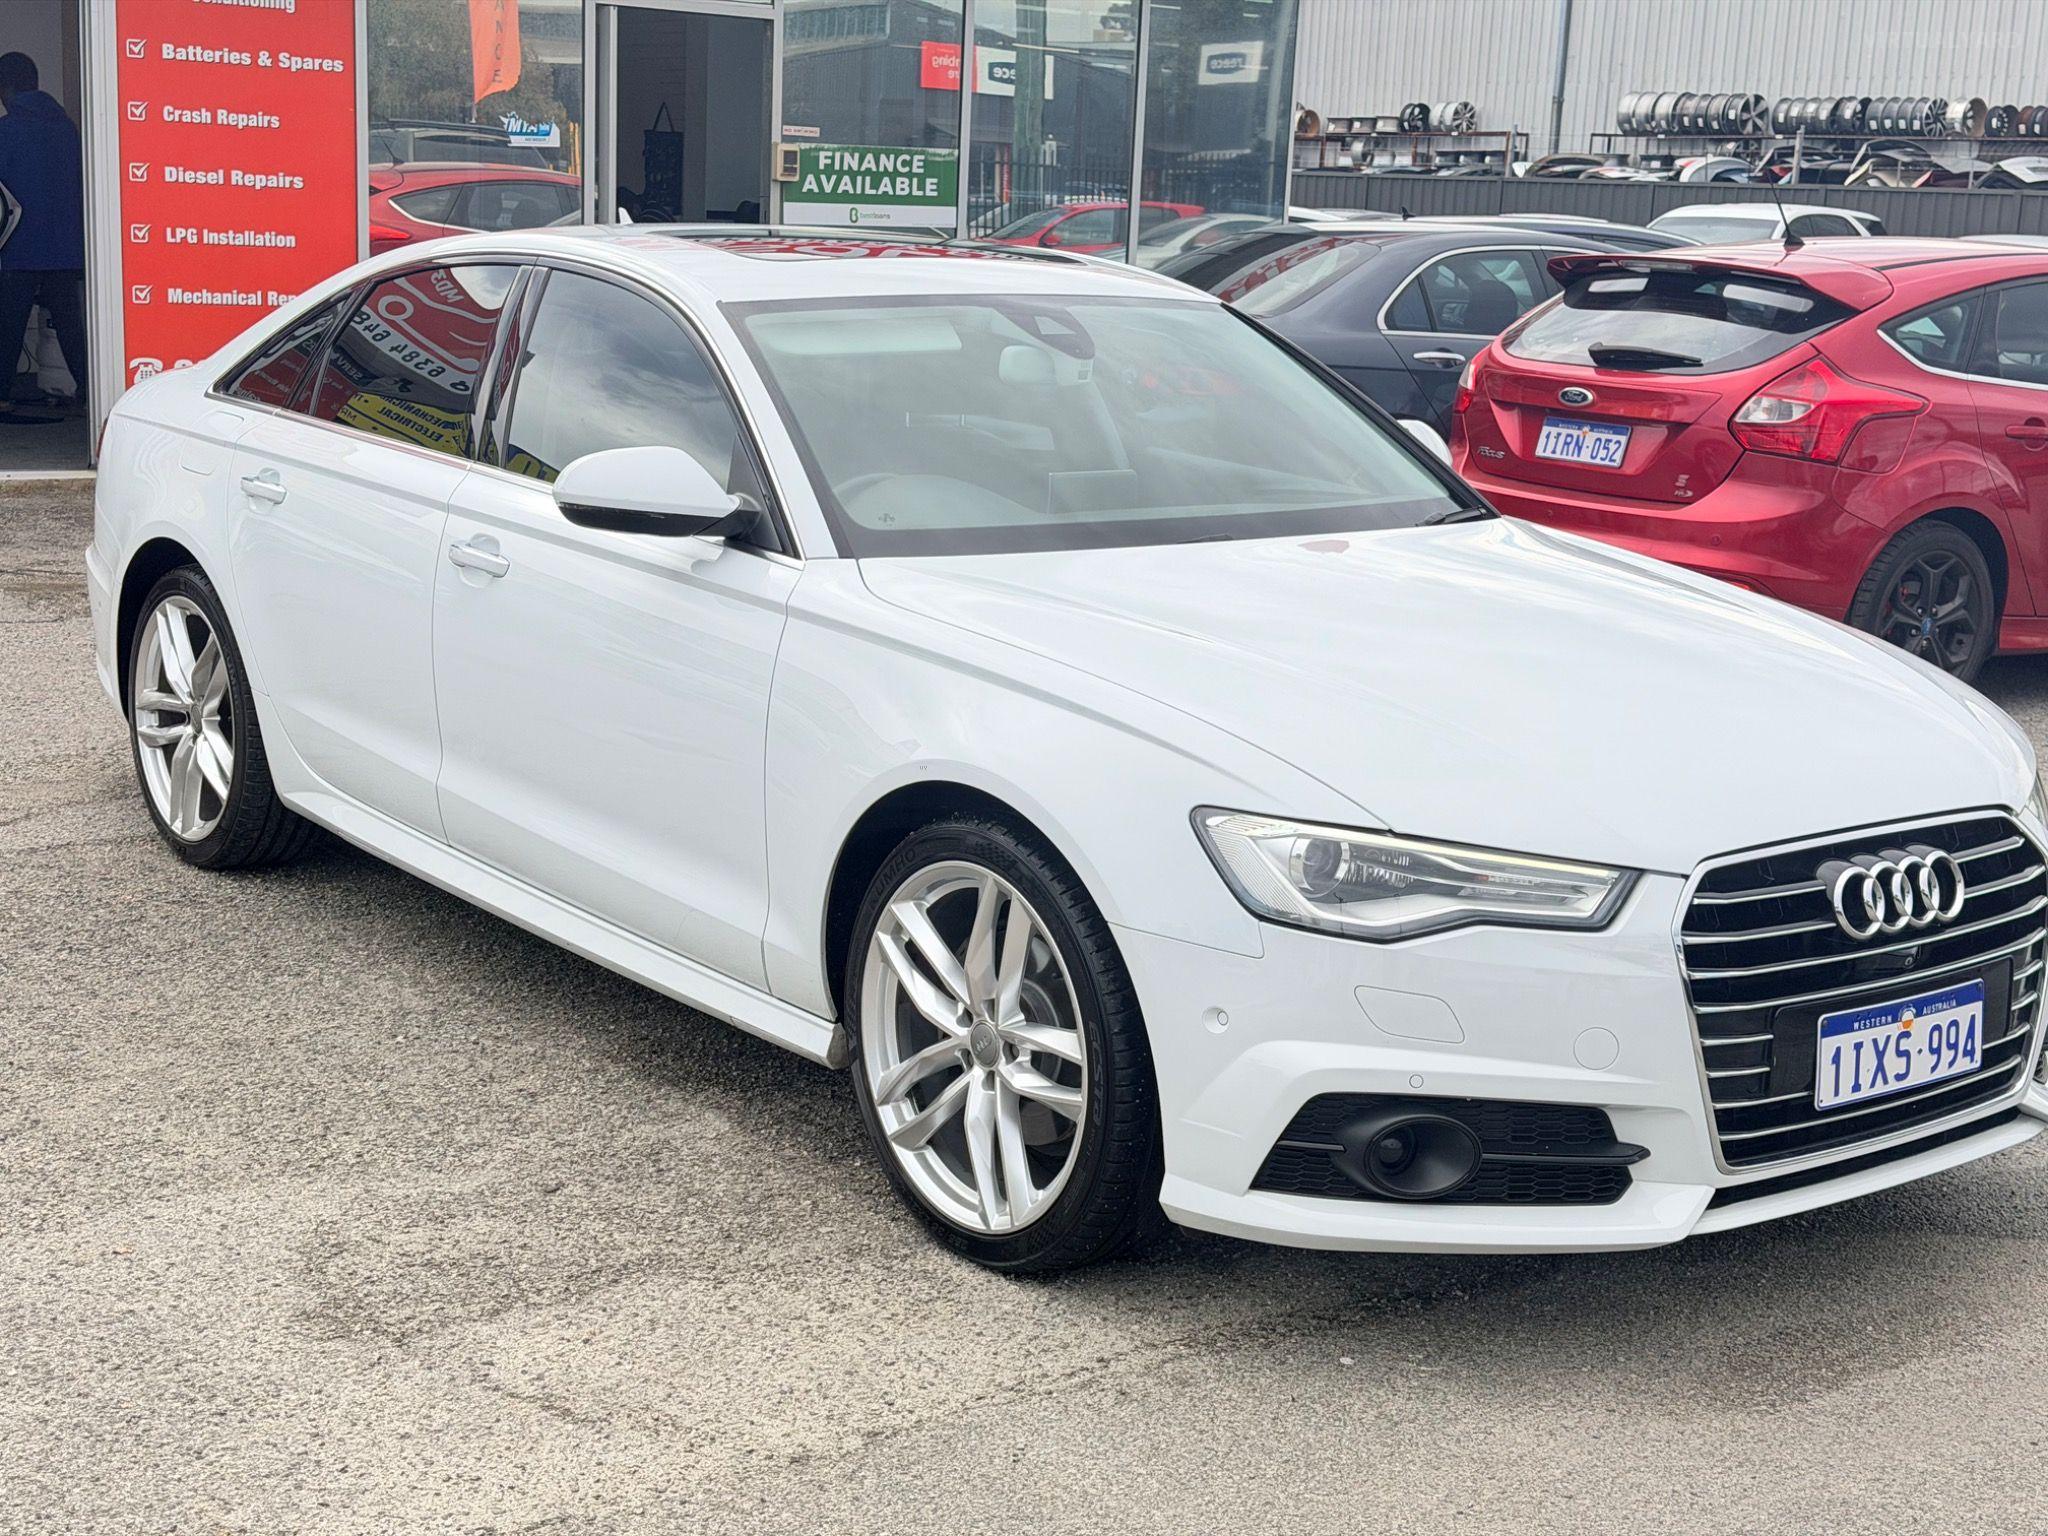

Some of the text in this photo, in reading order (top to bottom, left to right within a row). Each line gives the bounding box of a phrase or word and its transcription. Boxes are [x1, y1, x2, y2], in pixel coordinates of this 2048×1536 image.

[162, 43, 344, 72] Batteries & Spares
[163, 105, 280, 129] Crash Repairs
[818, 150, 926, 174] FINANCE
[164, 166, 304, 189] Diesel Repairs
[802, 174, 939, 197] AVAILABLE
[166, 227, 296, 248] LPG Installation
[167, 287, 299, 306] Mechanical Rep
[1853, 998, 1957, 1031] WESTERN AUSTRALIA
